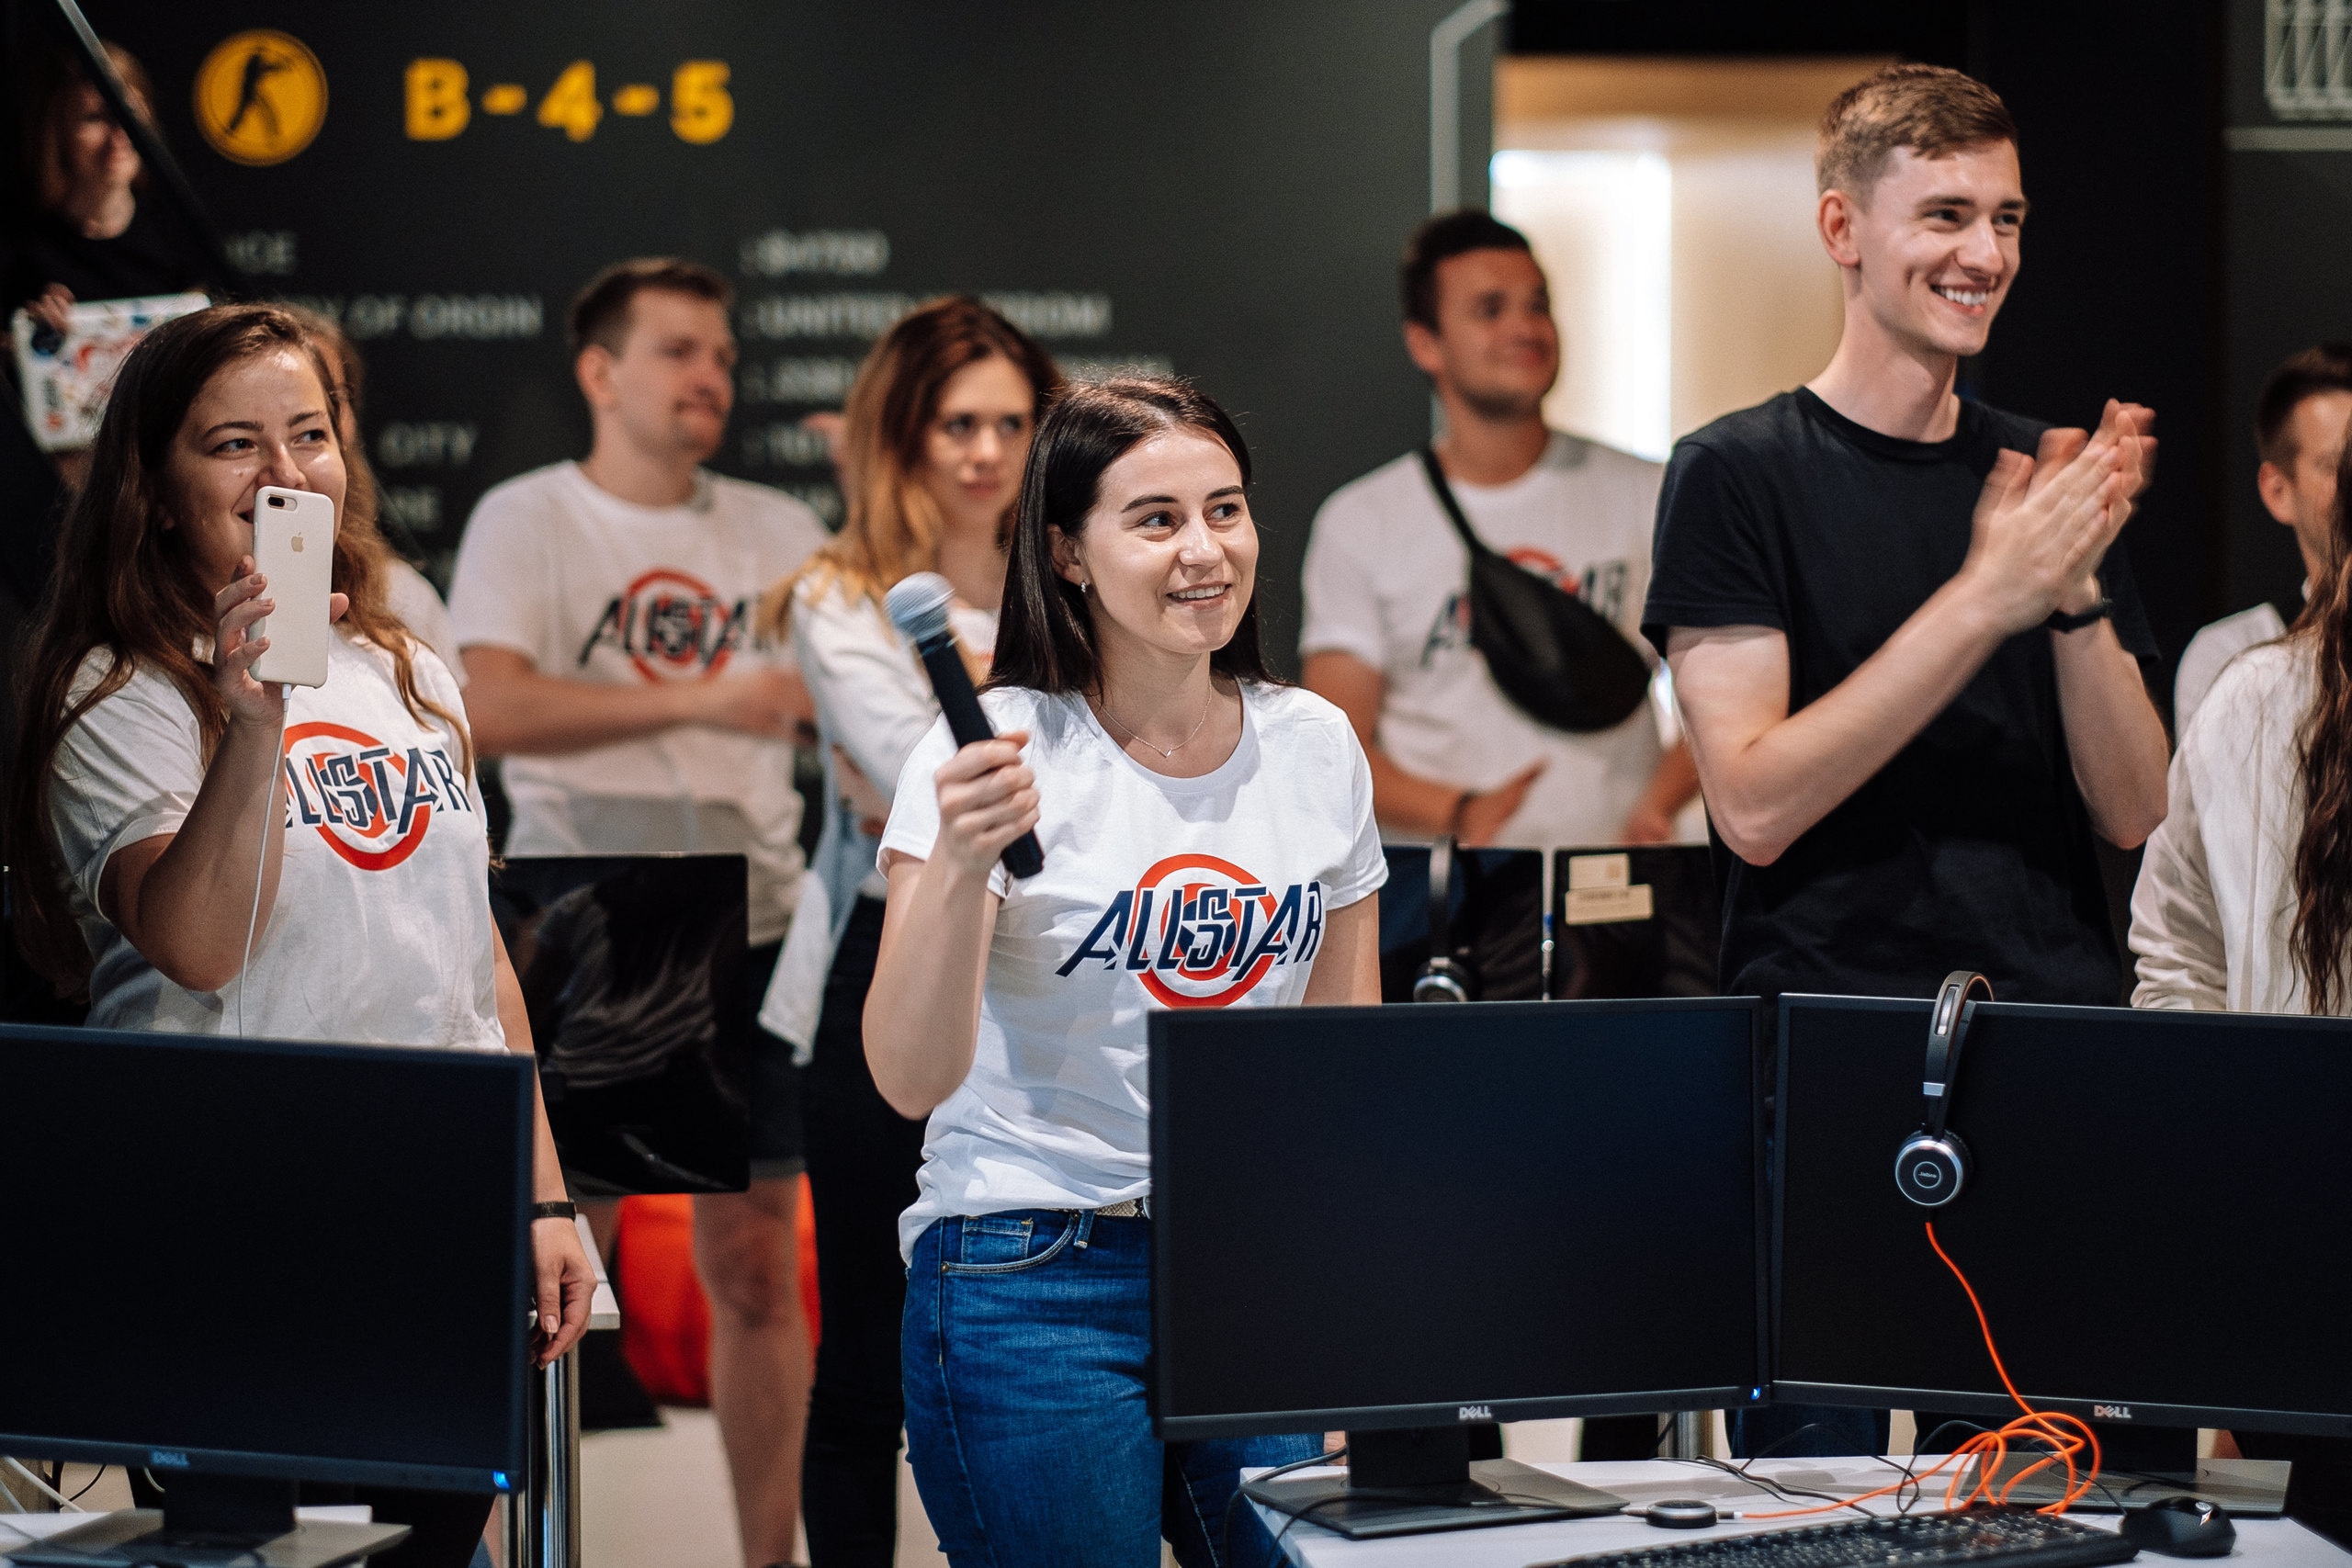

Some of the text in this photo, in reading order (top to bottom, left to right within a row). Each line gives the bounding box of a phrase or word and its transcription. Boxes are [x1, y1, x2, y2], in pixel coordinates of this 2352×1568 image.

[286, 747, 472, 834] LLSTAR
[1054, 880, 1323, 981] ALLSTAR
[1459, 1405, 1493, 1420] DELL
[2093, 1404, 2132, 1419] DELL
